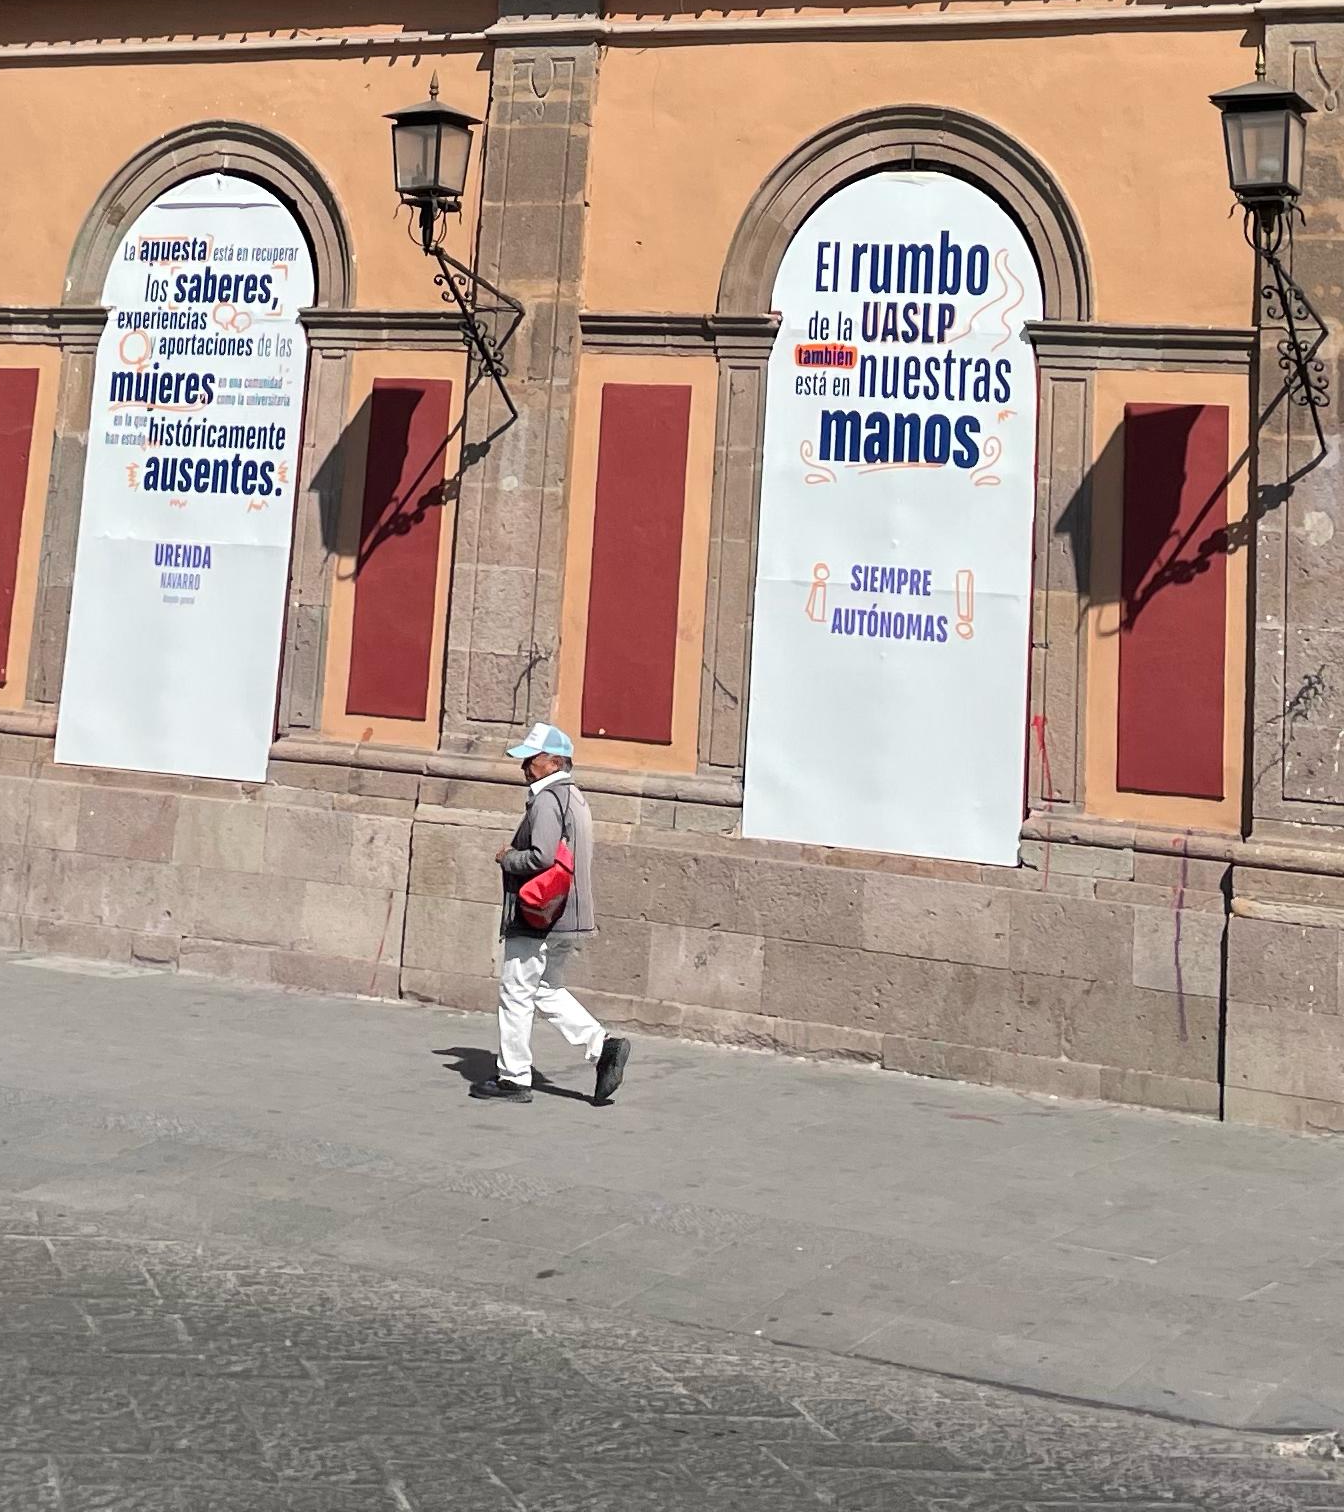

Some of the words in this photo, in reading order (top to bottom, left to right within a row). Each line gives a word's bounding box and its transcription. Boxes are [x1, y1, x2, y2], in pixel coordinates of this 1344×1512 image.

[124, 241, 136, 261] La
[140, 238, 207, 267] apuesta
[213, 243, 234, 262] está
[236, 248, 249, 262] en
[251, 247, 300, 267] recuperar
[815, 241, 841, 293] El
[850, 230, 990, 296] rumbo
[144, 273, 169, 303] los
[173, 266, 279, 310] saberes,
[117, 306, 208, 332] experiencias
[808, 310, 830, 341] de
[837, 311, 853, 341] la
[861, 301, 957, 345] UASLP
[159, 332, 254, 360] aportaciones
[257, 333, 272, 358] de
[275, 332, 293, 358] las
[798, 343, 855, 367] también
[109, 361, 216, 412] mujeres
[795, 371, 828, 397] está
[832, 376, 851, 397] en
[858, 349, 1012, 404] nuestras
[148, 416, 287, 450] históricamente
[819, 409, 981, 469] manos
[143, 453, 283, 497] ausentes.
[154, 543, 212, 569] URENDA
[160, 572, 201, 590] NAVARRO
[850, 563, 933, 597] SIEMPRE
[831, 603, 949, 643] AUTÓNOMAS
